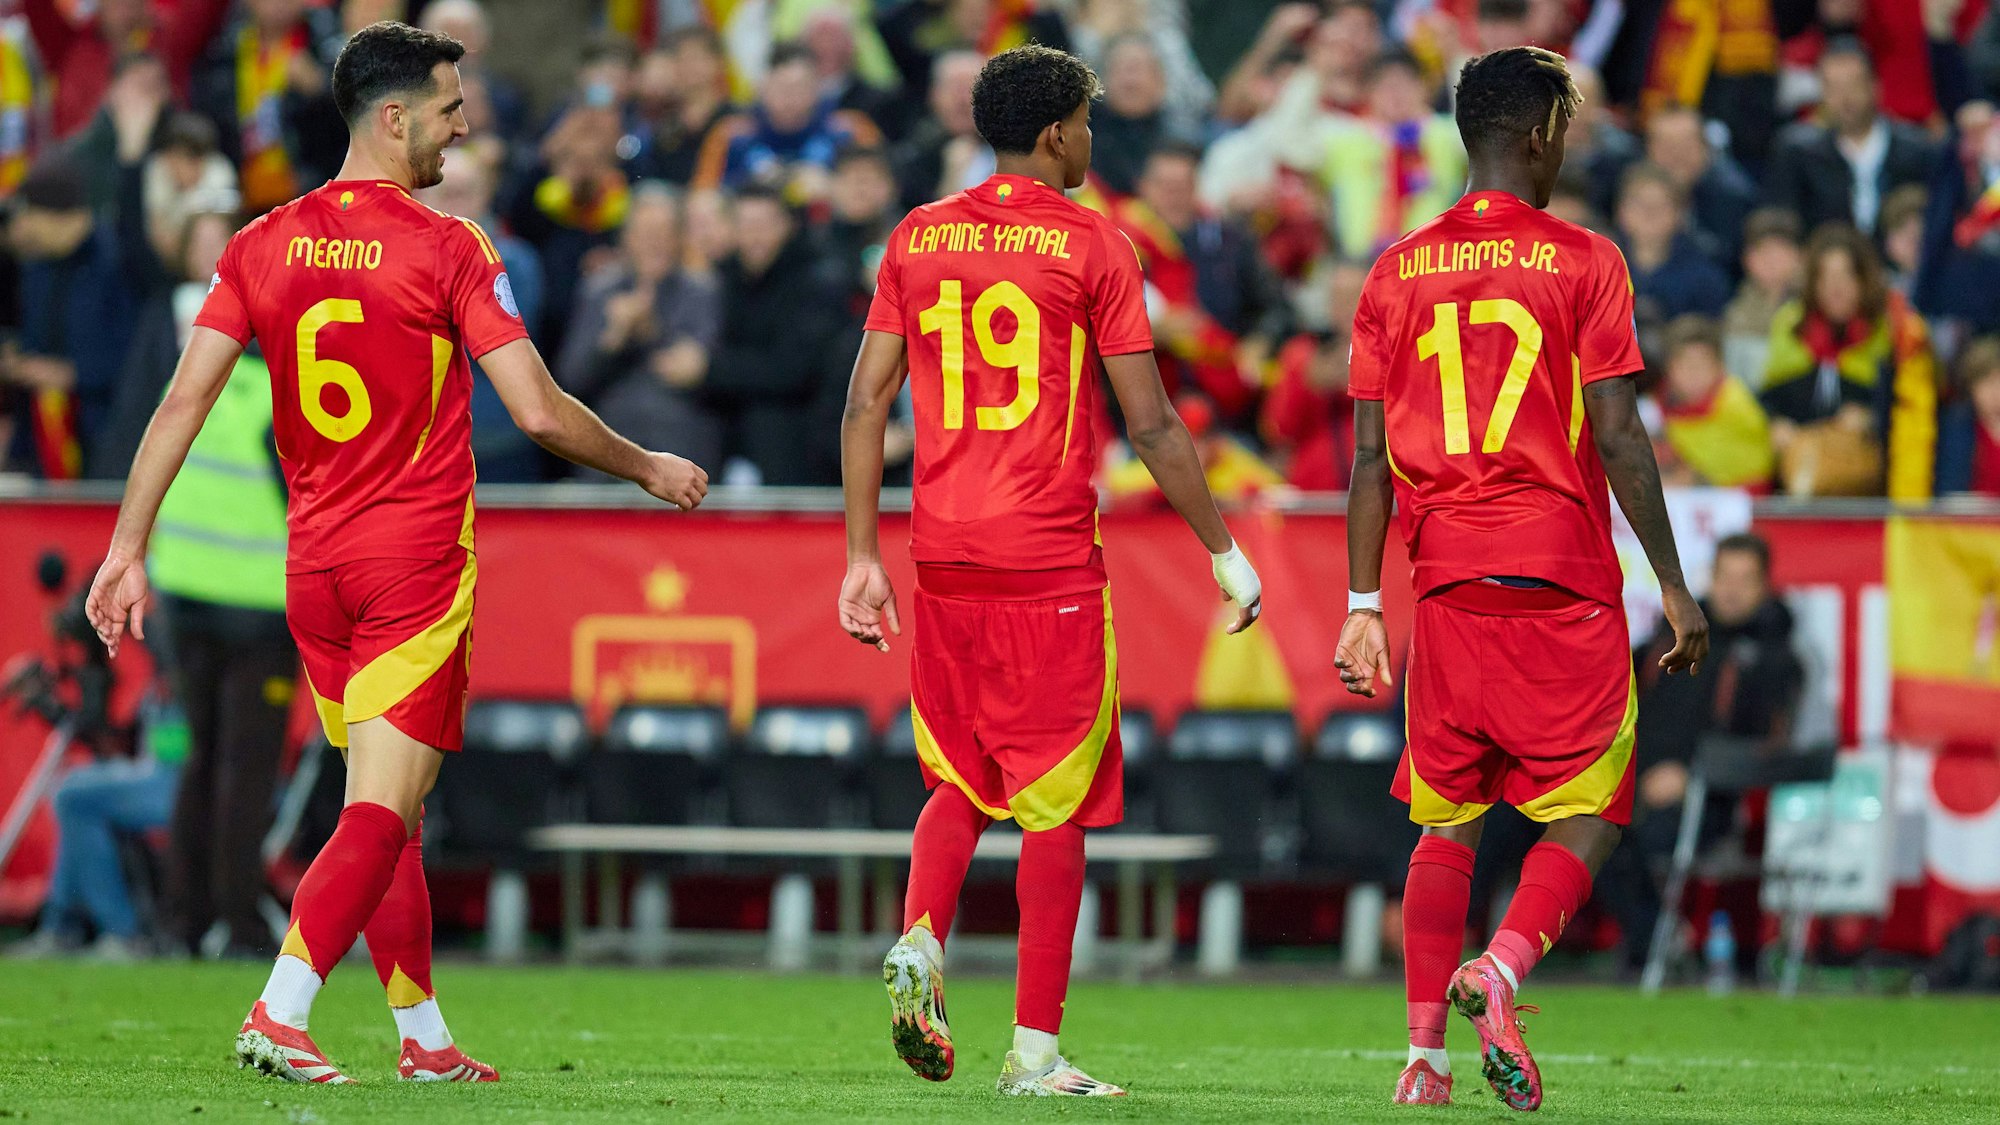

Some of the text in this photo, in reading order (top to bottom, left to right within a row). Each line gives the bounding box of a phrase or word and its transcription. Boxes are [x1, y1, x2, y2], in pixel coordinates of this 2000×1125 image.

[286, 236, 382, 270] MERINO
[908, 223, 1071, 259] LAMINE YAMAL
[1399, 239, 1559, 280] WILLIAMS JR.
[297, 298, 372, 442] 6
[919, 280, 1041, 431] 19
[1417, 298, 1543, 455] 17
